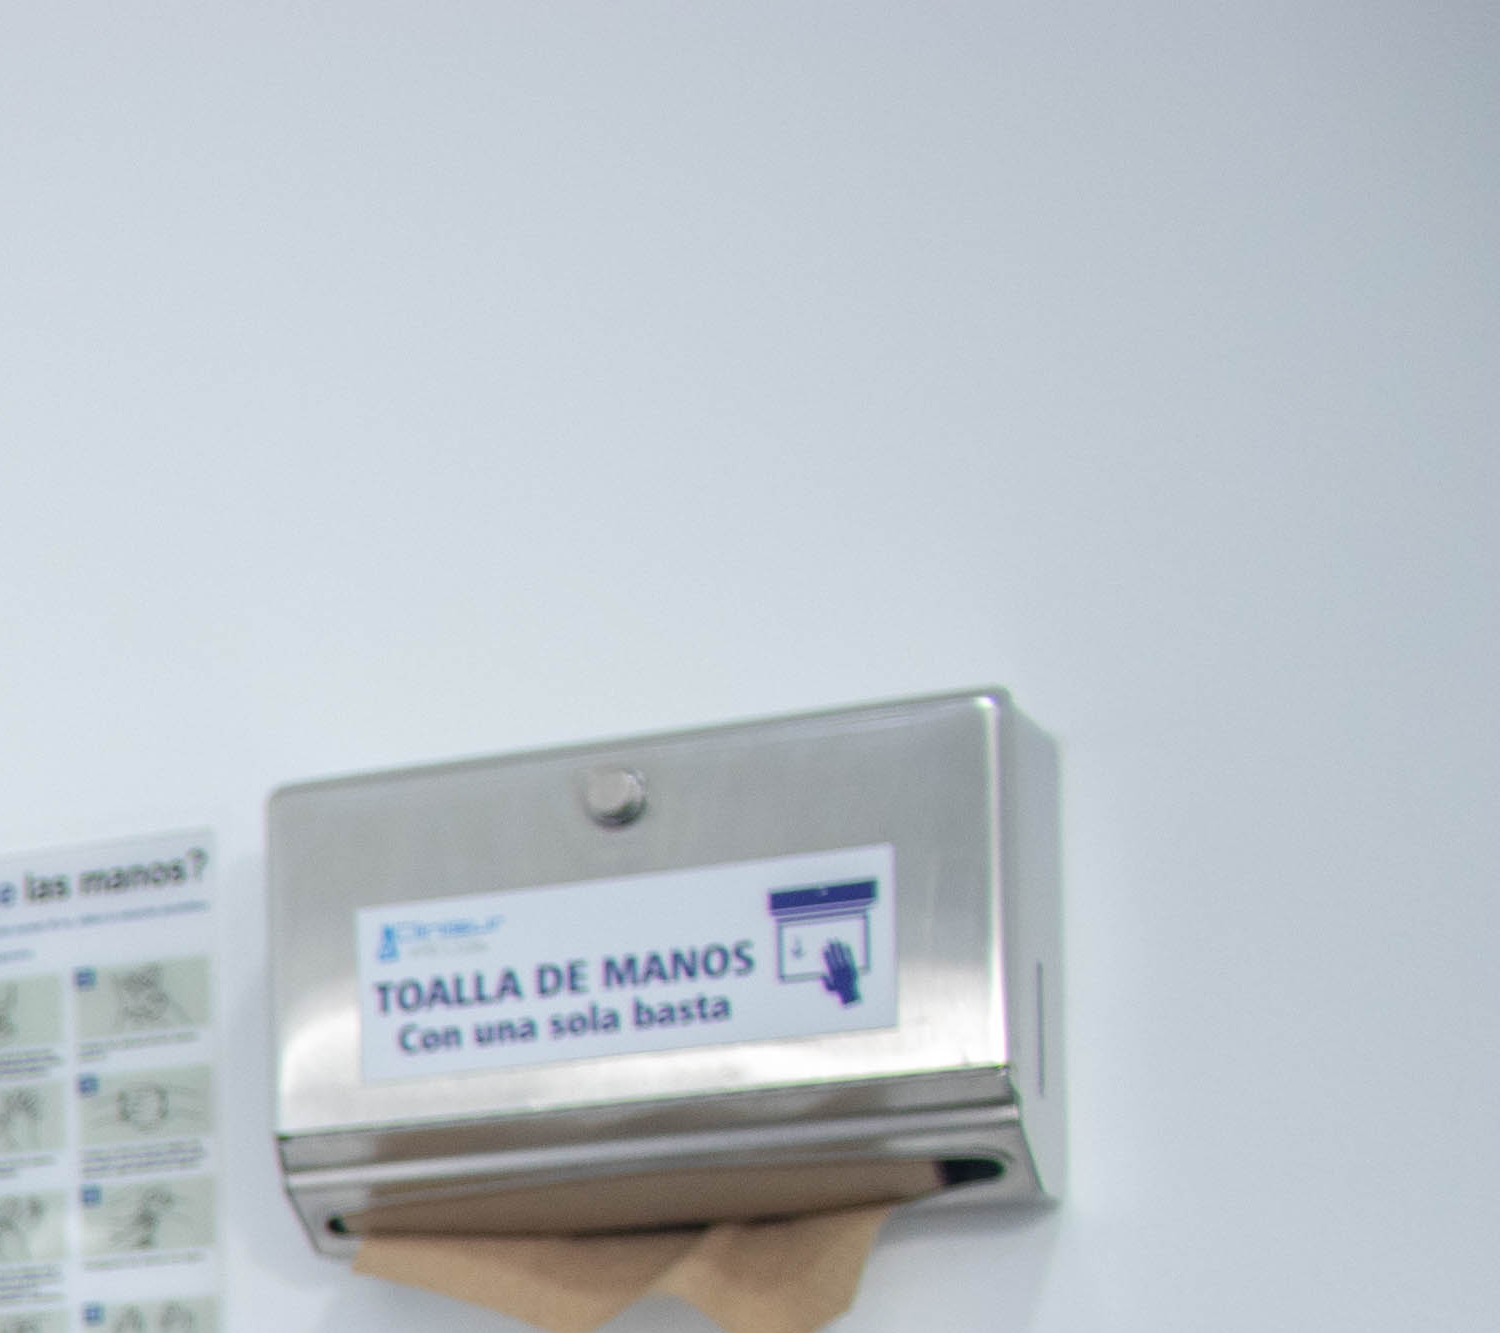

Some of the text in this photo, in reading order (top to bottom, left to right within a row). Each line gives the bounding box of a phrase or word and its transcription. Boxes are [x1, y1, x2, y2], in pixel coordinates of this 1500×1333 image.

[24, 870, 71, 901] las
[79, 847, 208, 893] manos?
[374, 941, 756, 1014] TOALLA DE MANOS
[399, 994, 732, 1054] Con una sola basta
